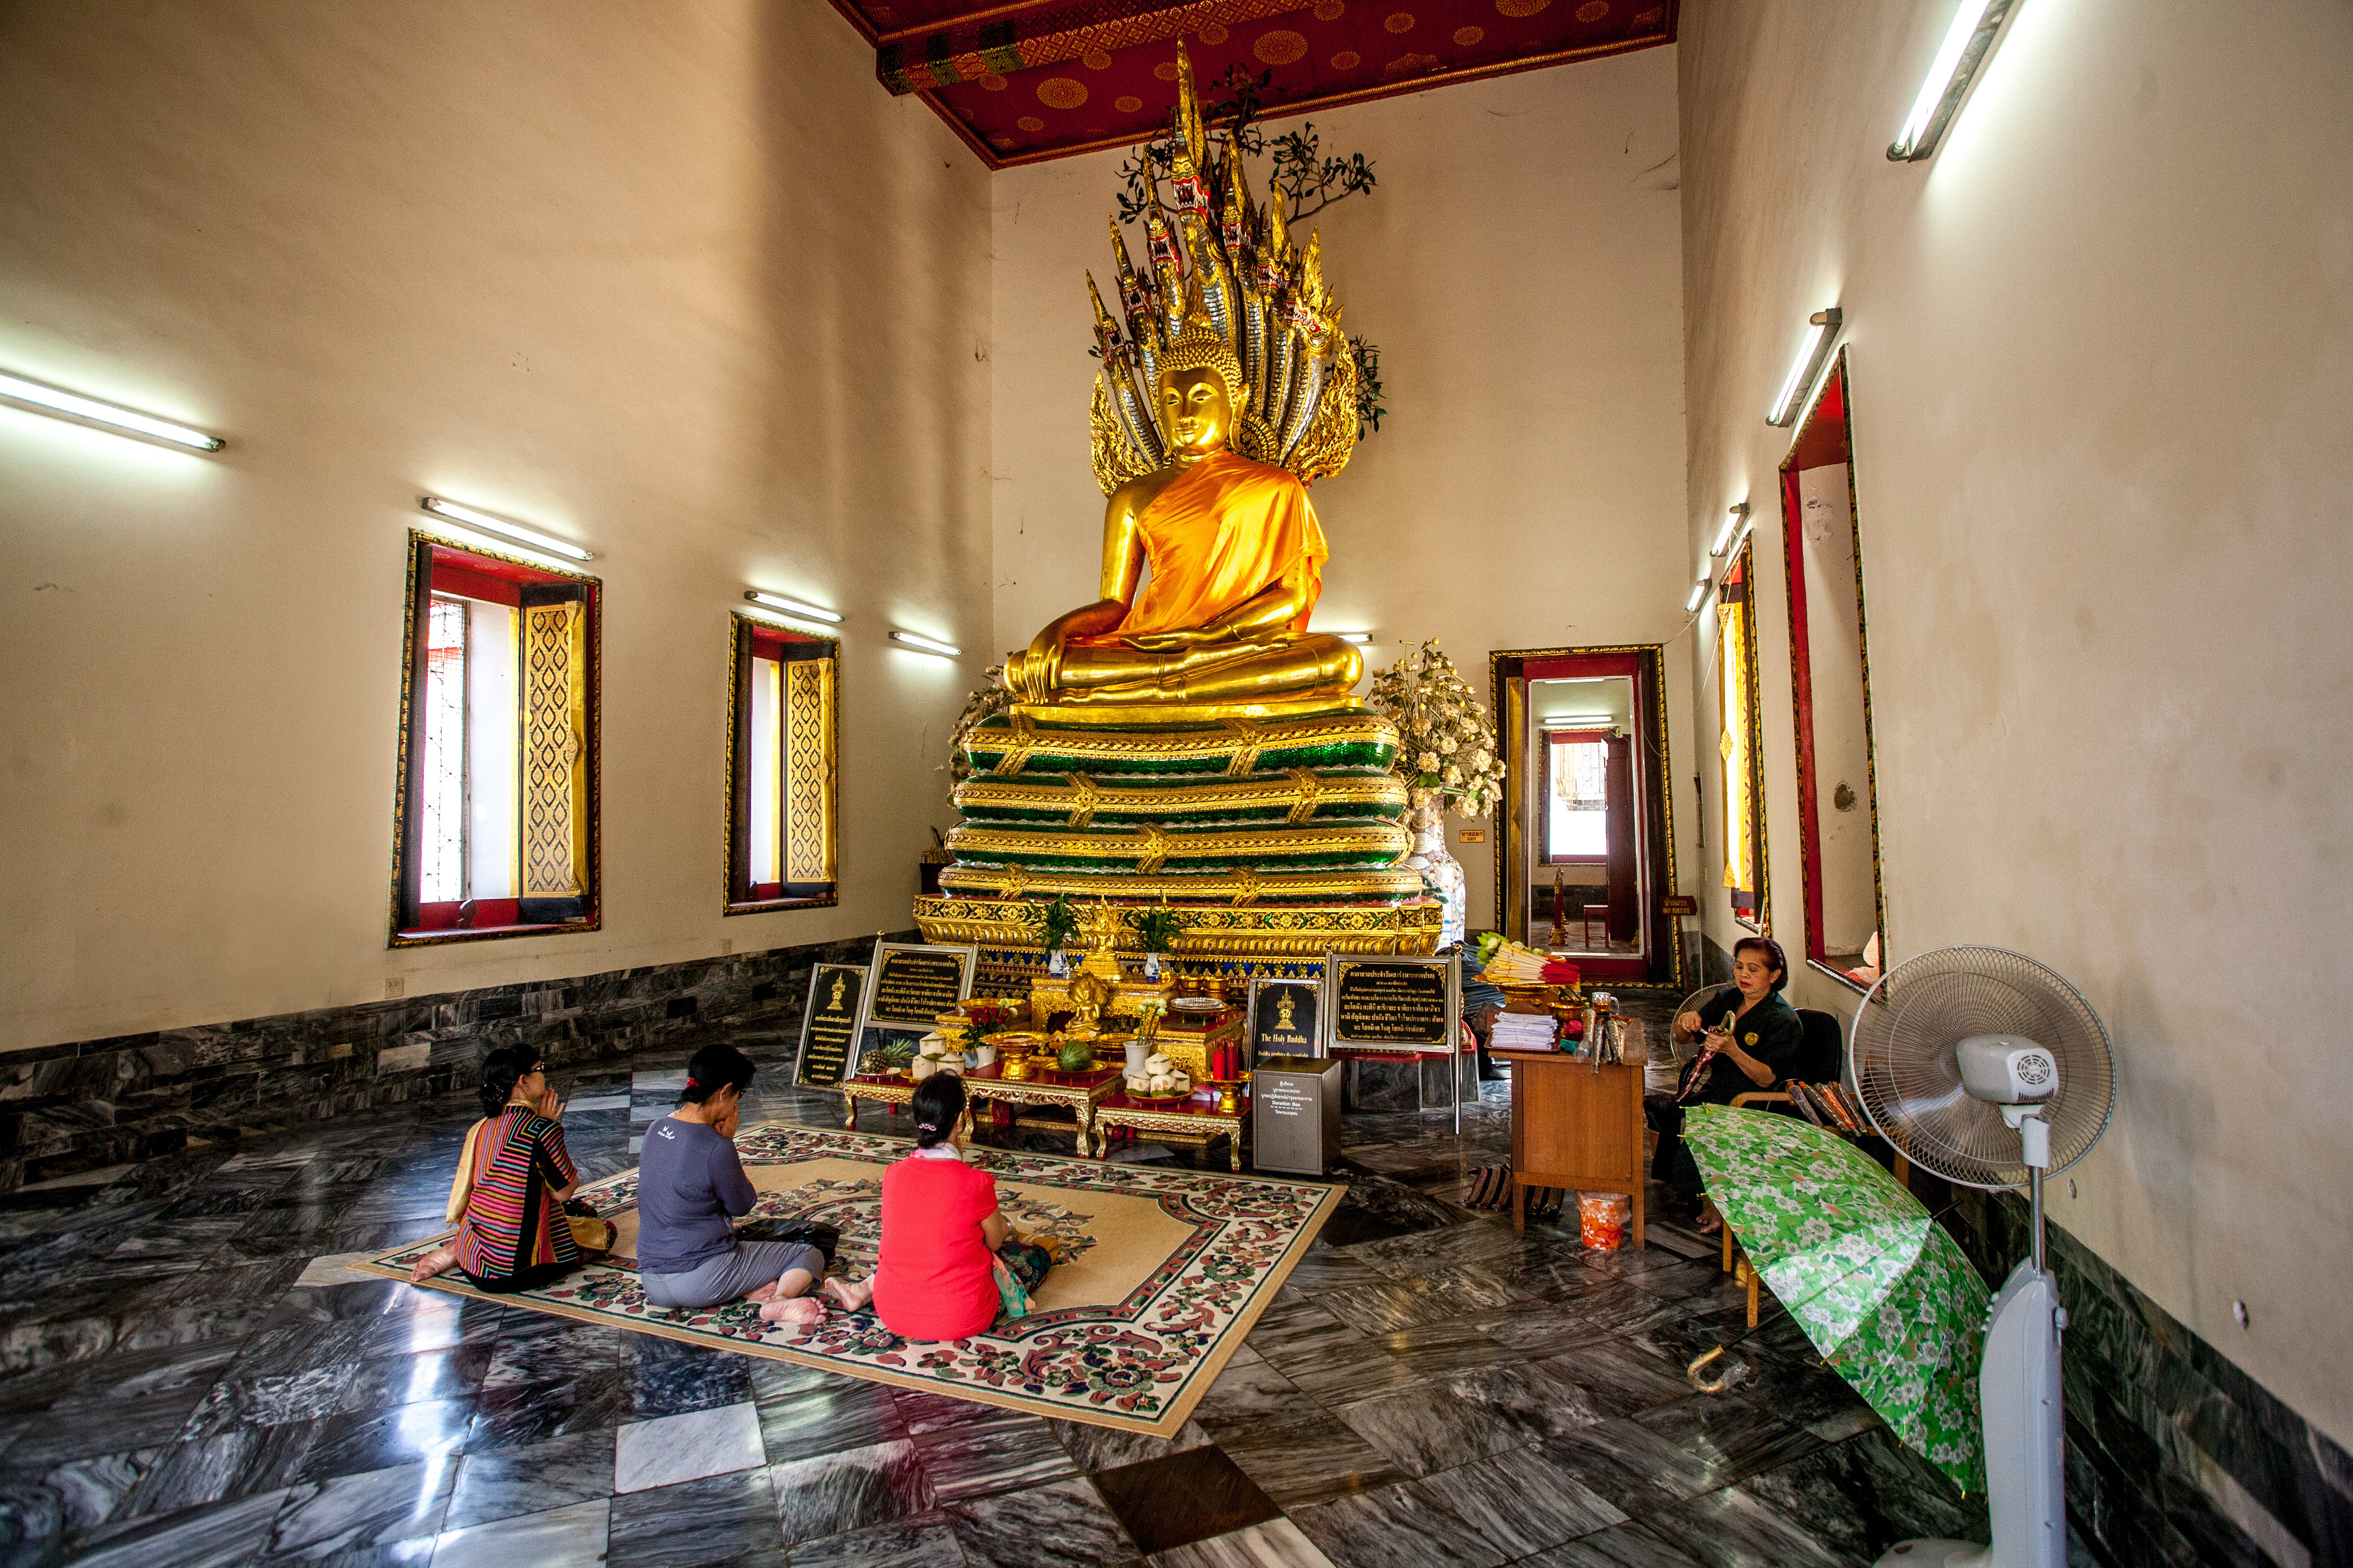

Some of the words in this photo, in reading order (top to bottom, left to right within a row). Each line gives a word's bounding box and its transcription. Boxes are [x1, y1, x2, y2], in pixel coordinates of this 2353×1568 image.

[1262, 1034, 1271, 1042] The
[1273, 1034, 1285, 1045] Holy
[1287, 1035, 1306, 1044] Buddha
